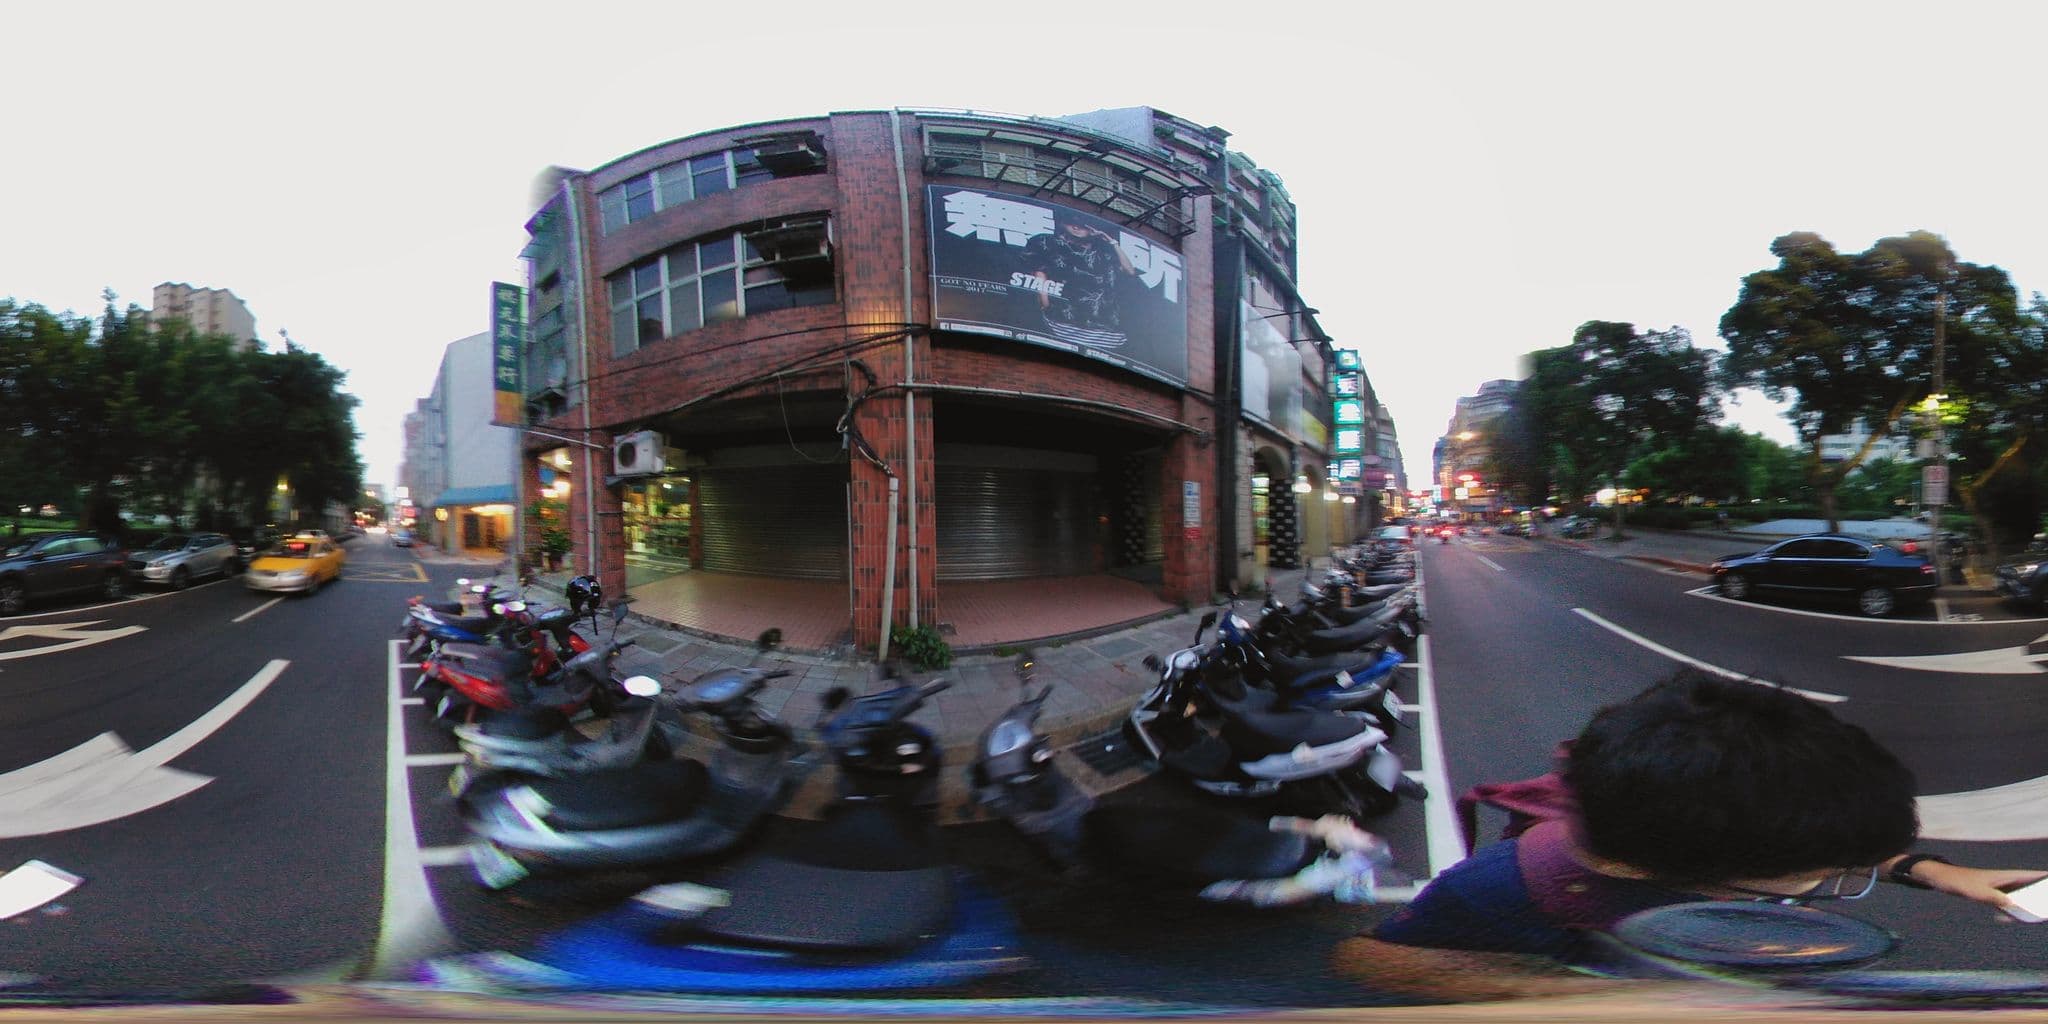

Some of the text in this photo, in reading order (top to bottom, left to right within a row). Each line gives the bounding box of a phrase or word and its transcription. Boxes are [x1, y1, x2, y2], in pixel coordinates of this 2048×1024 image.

[940, 278, 1007, 292] GOT NO FEARS
[1010, 272, 1064, 296] STAGE
